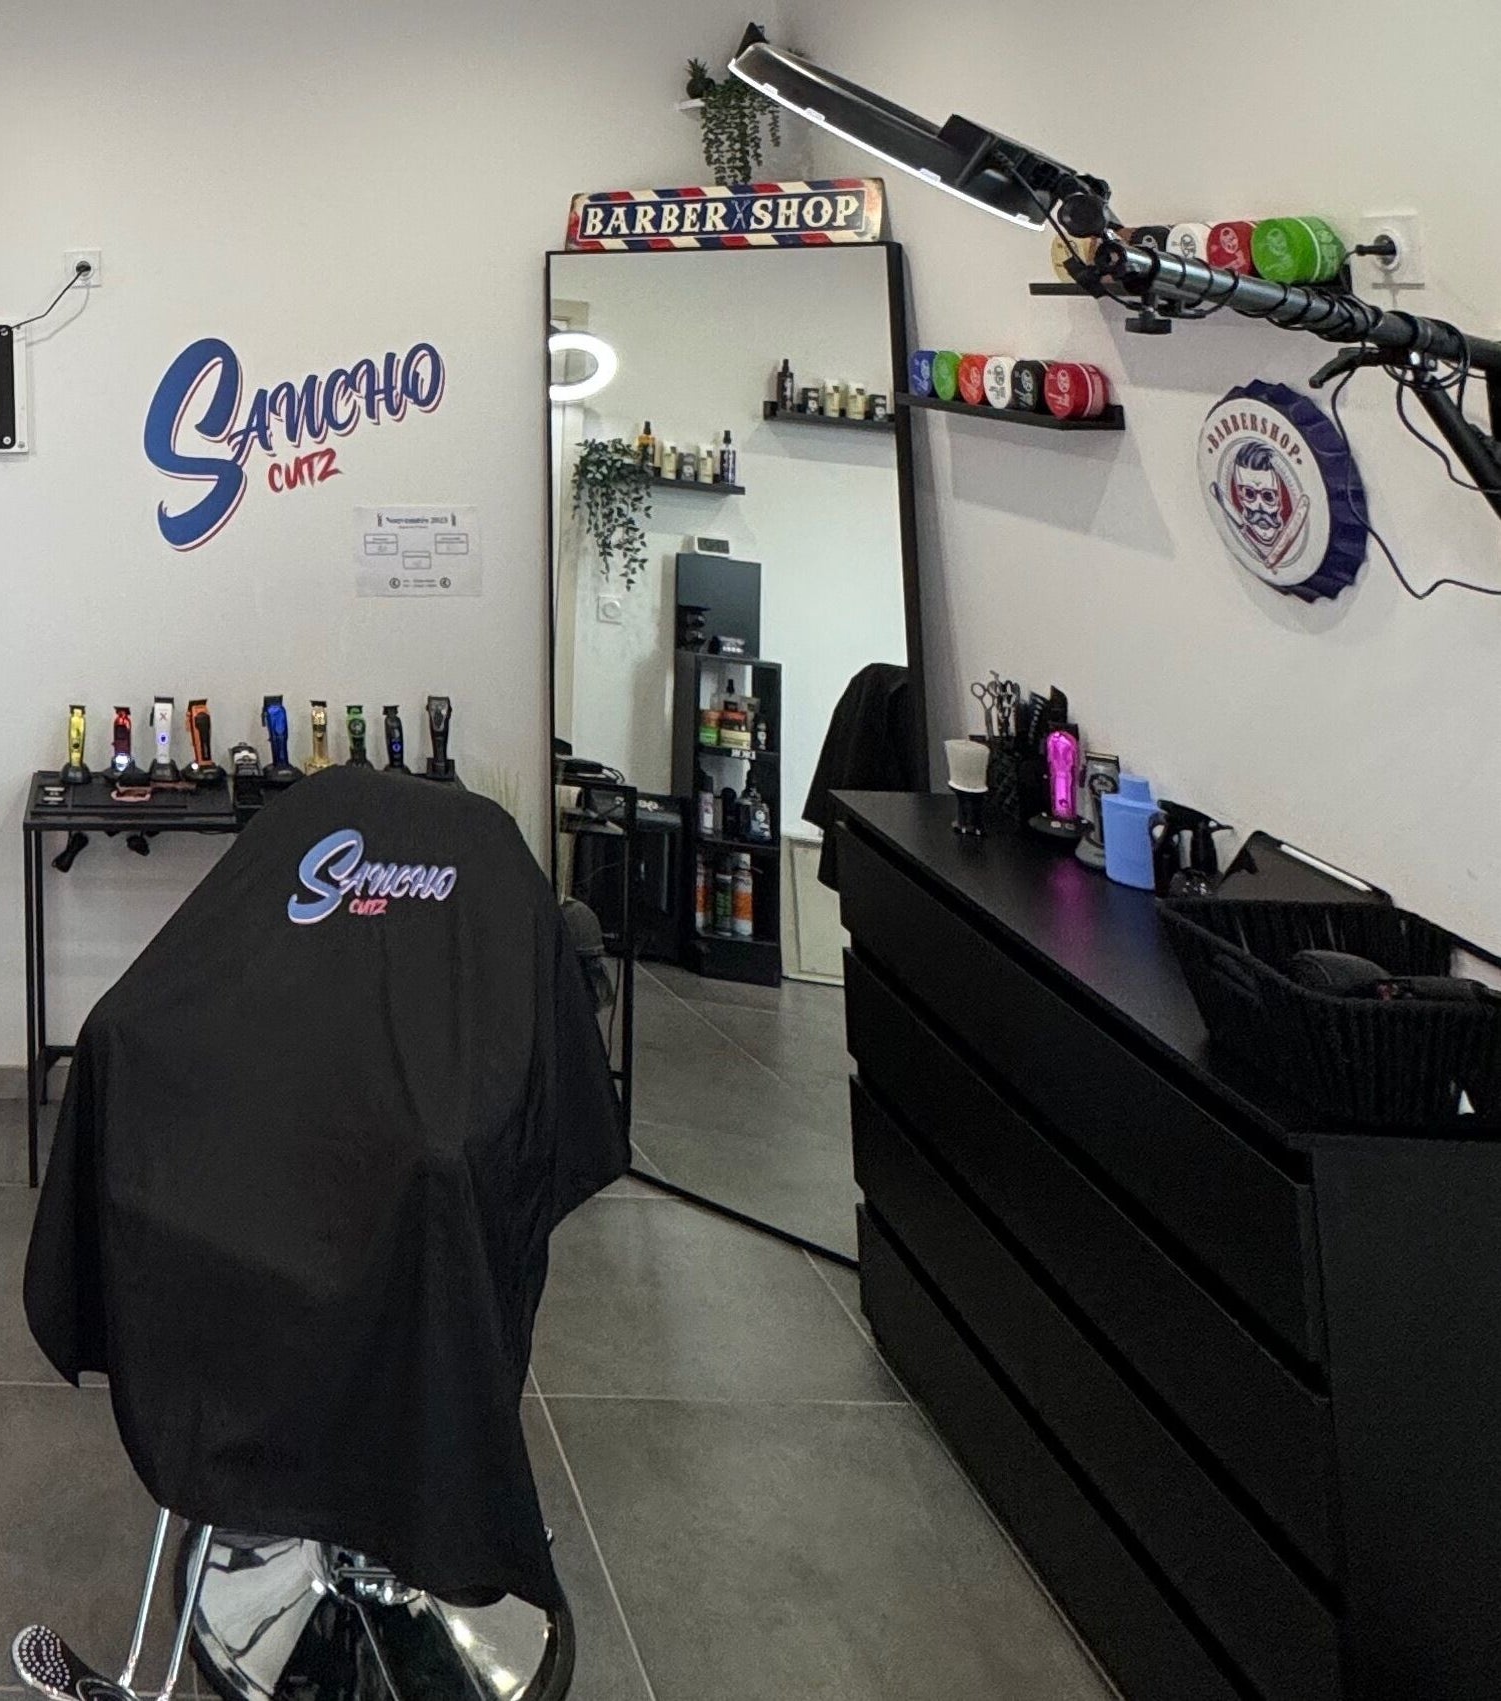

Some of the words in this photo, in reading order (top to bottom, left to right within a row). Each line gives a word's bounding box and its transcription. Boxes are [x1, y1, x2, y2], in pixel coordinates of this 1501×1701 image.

[584, 201, 730, 236] BARBER
[749, 195, 861, 231] SHOP
[143, 337, 445, 552] SANCHO
[1207, 412, 1299, 458] BARBERSHOP
[267, 447, 343, 493] CUTZ
[288, 828, 458, 925] SANCHO
[348, 898, 388, 916] CUTZ
